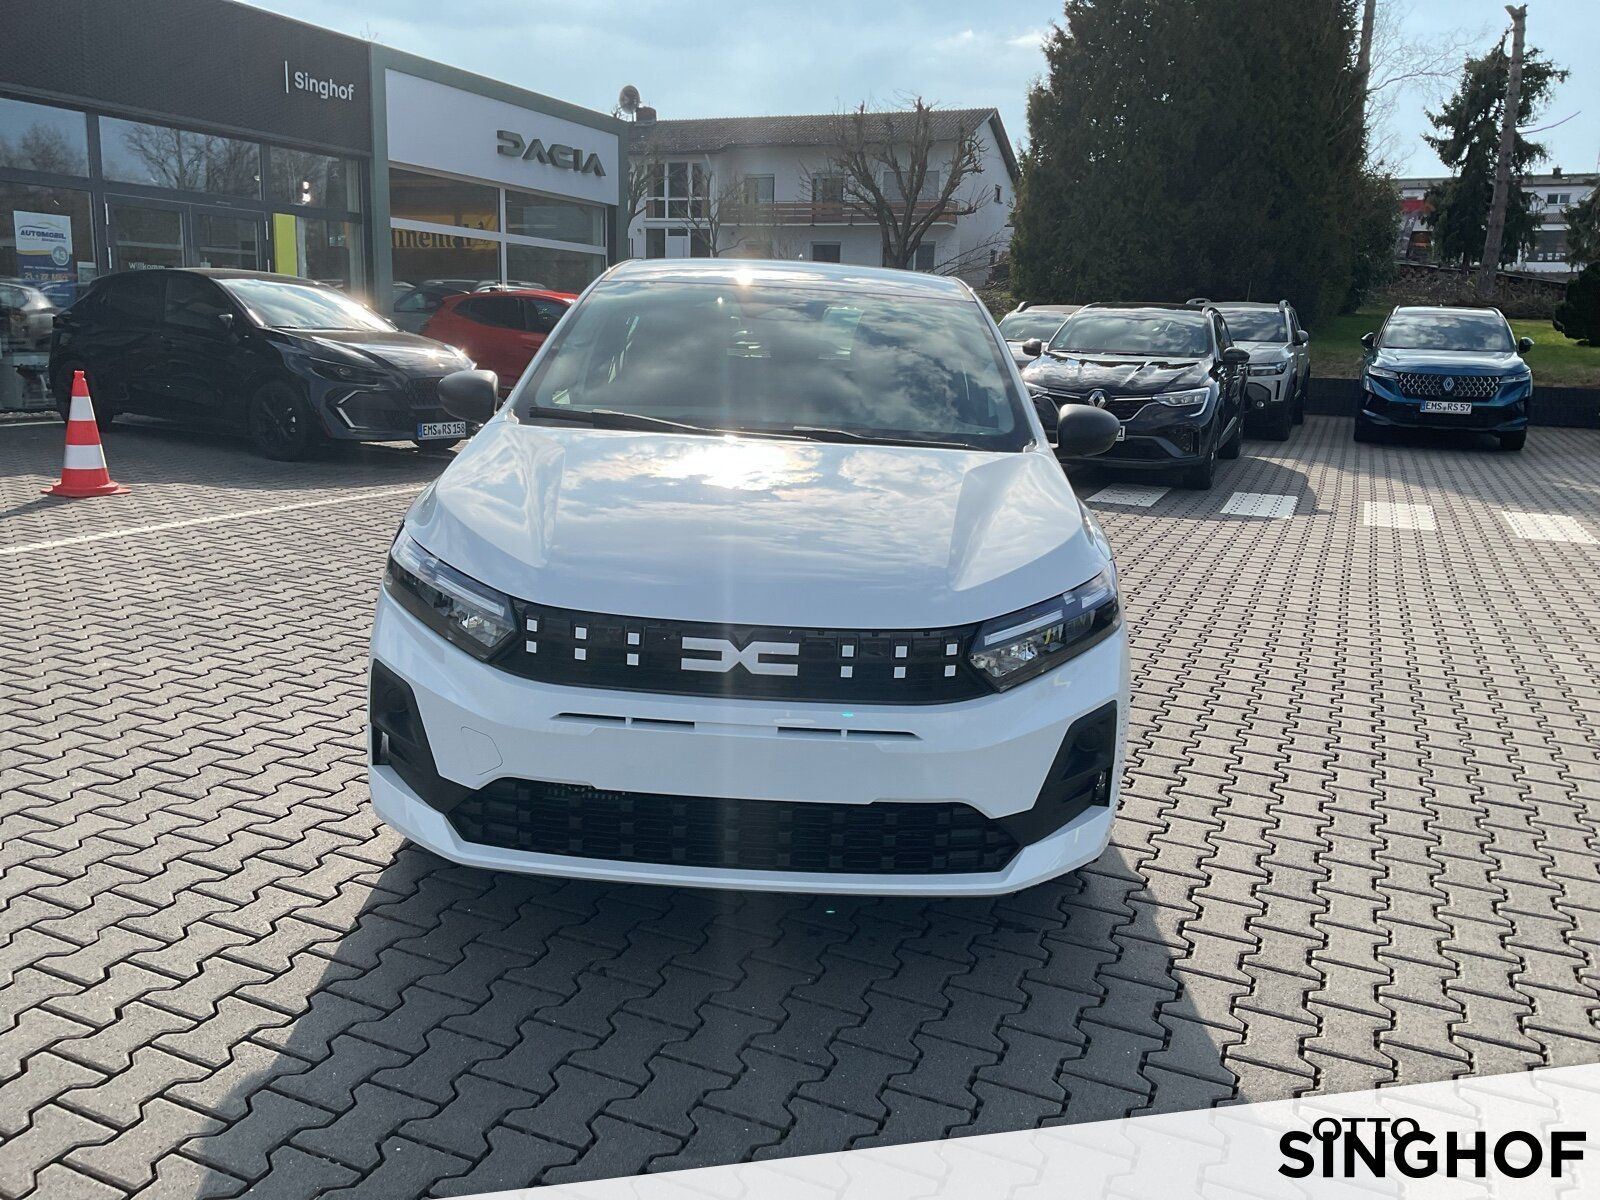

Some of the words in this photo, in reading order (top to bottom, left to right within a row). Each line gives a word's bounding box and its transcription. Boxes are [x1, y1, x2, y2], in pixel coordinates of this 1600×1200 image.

[294, 71, 354, 101] Singhof
[497, 130, 606, 176] DACIA
[20, 229, 67, 240] AUTOMOBIL
[1425, 401, 1443, 410] EMS
[1447, 402, 1459, 411] RS
[1460, 403, 1471, 412] 57
[423, 424, 438, 436] EMS
[442, 424, 452, 435] RS
[453, 423, 465, 434] 158
